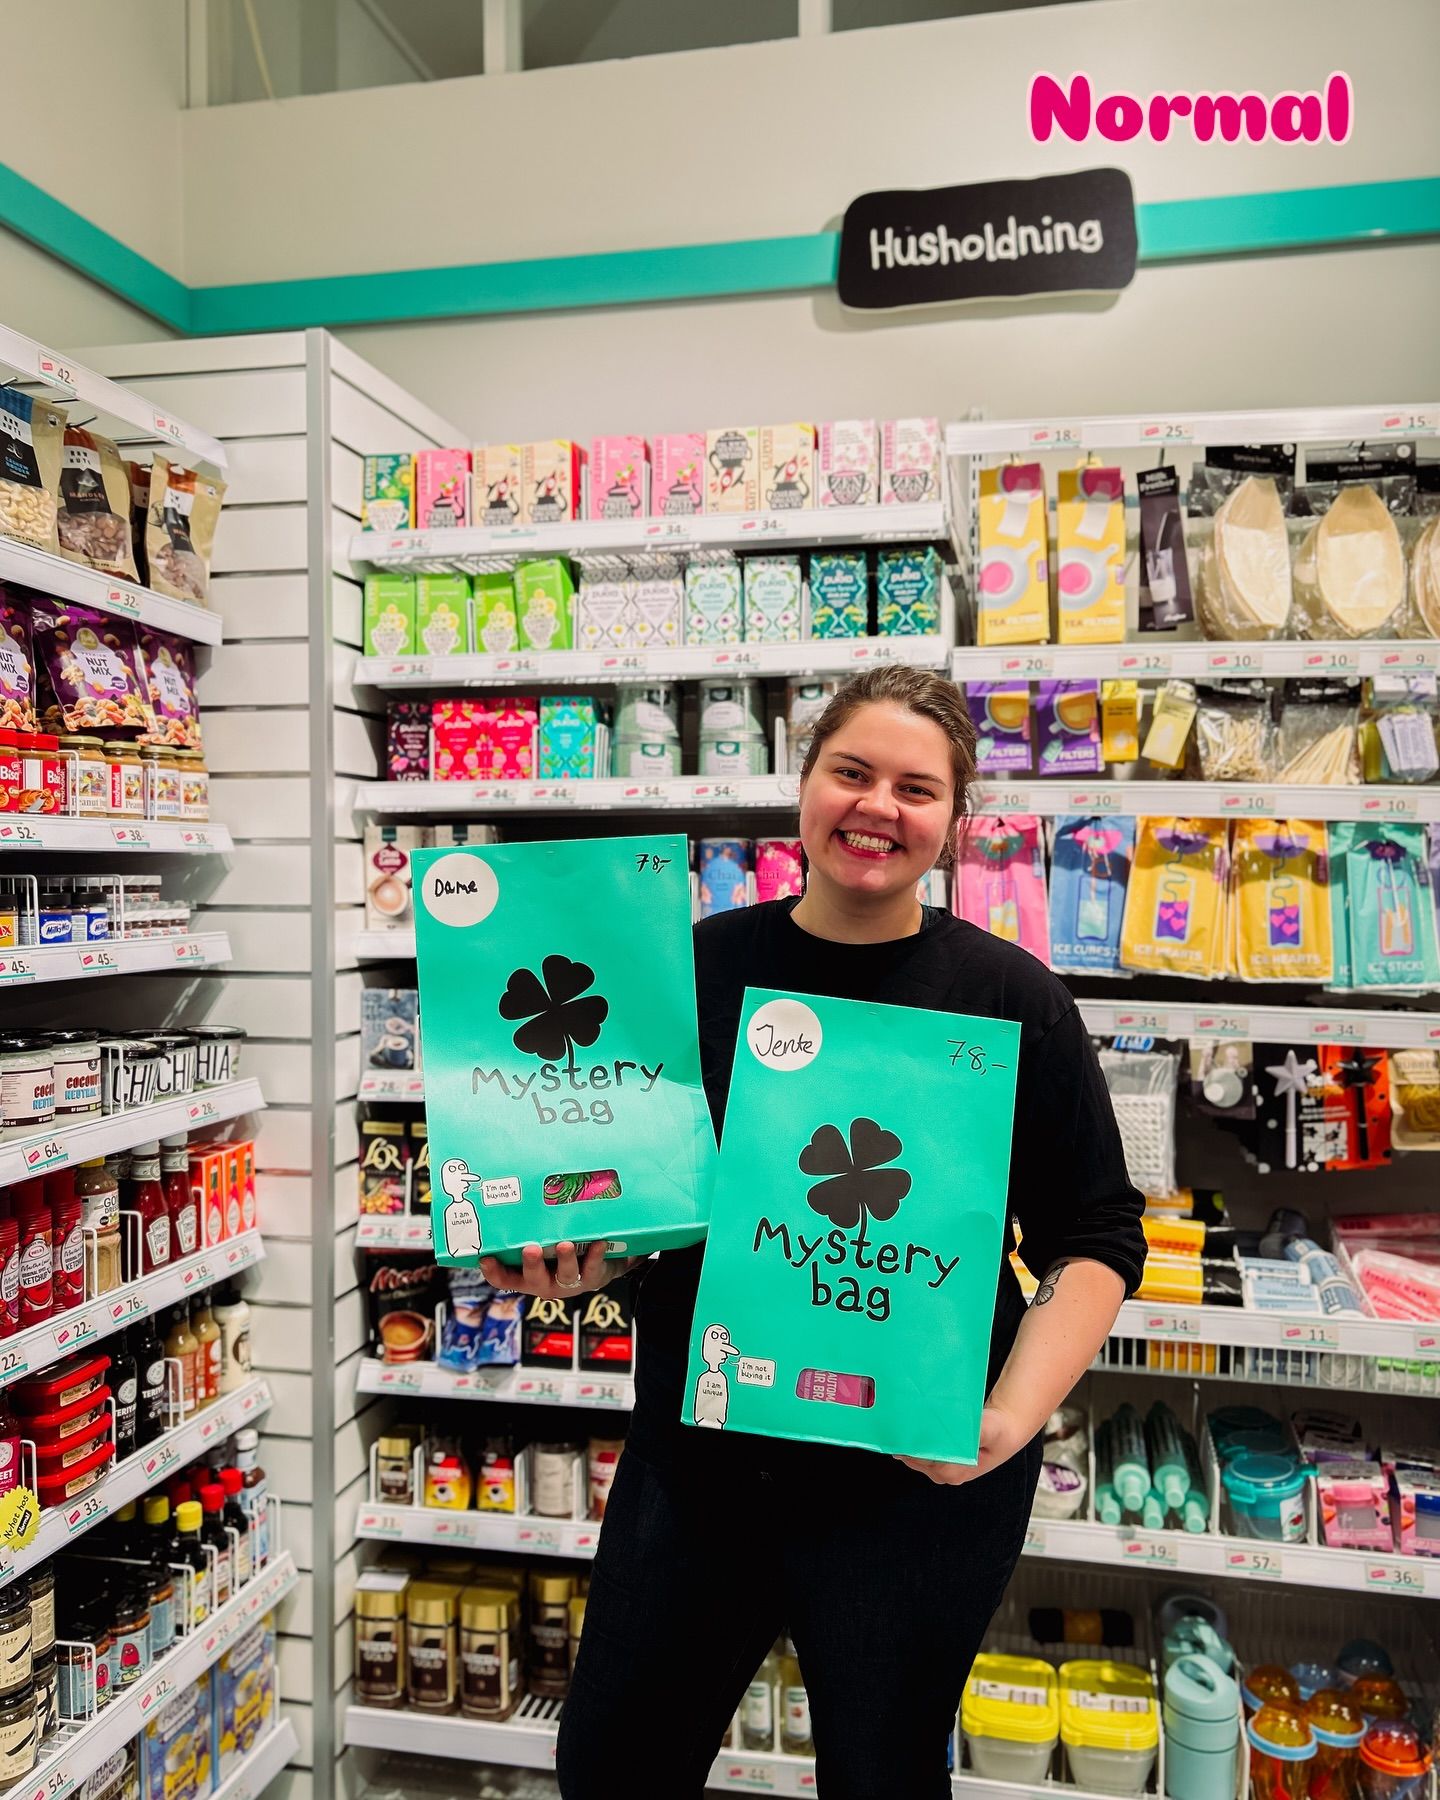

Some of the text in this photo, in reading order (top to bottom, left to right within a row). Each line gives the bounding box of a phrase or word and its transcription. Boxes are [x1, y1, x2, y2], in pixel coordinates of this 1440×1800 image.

[869, 216, 1103, 270] Husholdning
[86, 656, 107, 668] NUT
[91, 665, 112, 677] MIX
[434, 878, 478, 898] Dame
[196, 1045, 230, 1081] HIA
[471, 1060, 664, 1100] Mystery
[531, 1092, 615, 1124] bag
[486, 1189, 517, 1200] buying it
[451, 1217, 473, 1227] unique
[753, 1217, 959, 1288] Mystery
[811, 1261, 891, 1321] bag
[742, 1361, 767, 1372] I'm not
[741, 1369, 771, 1381] buying it
[703, 1388, 723, 1398] unique
